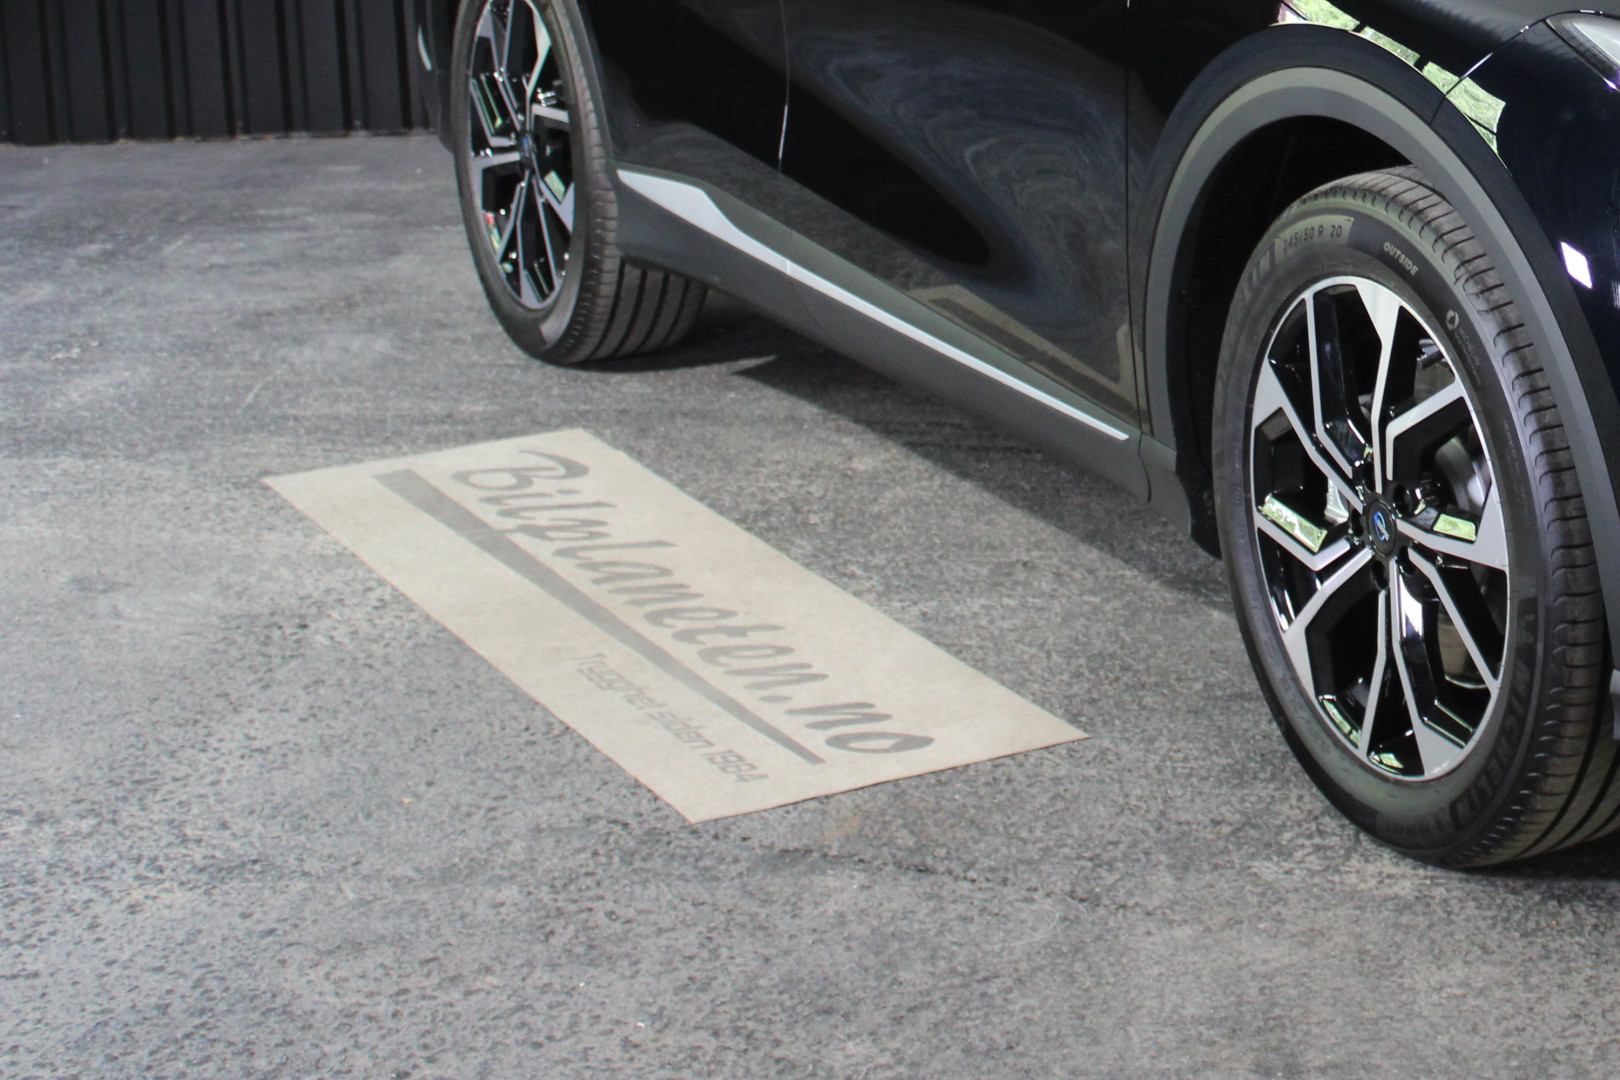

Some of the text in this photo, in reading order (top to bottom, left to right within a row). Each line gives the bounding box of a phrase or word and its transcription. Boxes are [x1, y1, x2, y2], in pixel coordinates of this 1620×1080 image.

[1317, 225, 1324, 238] R
[1329, 224, 1343, 238] 20
[1383, 241, 1419, 276] OUTSIDE
[450, 450, 936, 755] Bilplaneten.no
[647, 711, 716, 750] siden
[700, 748, 770, 784] 1984
